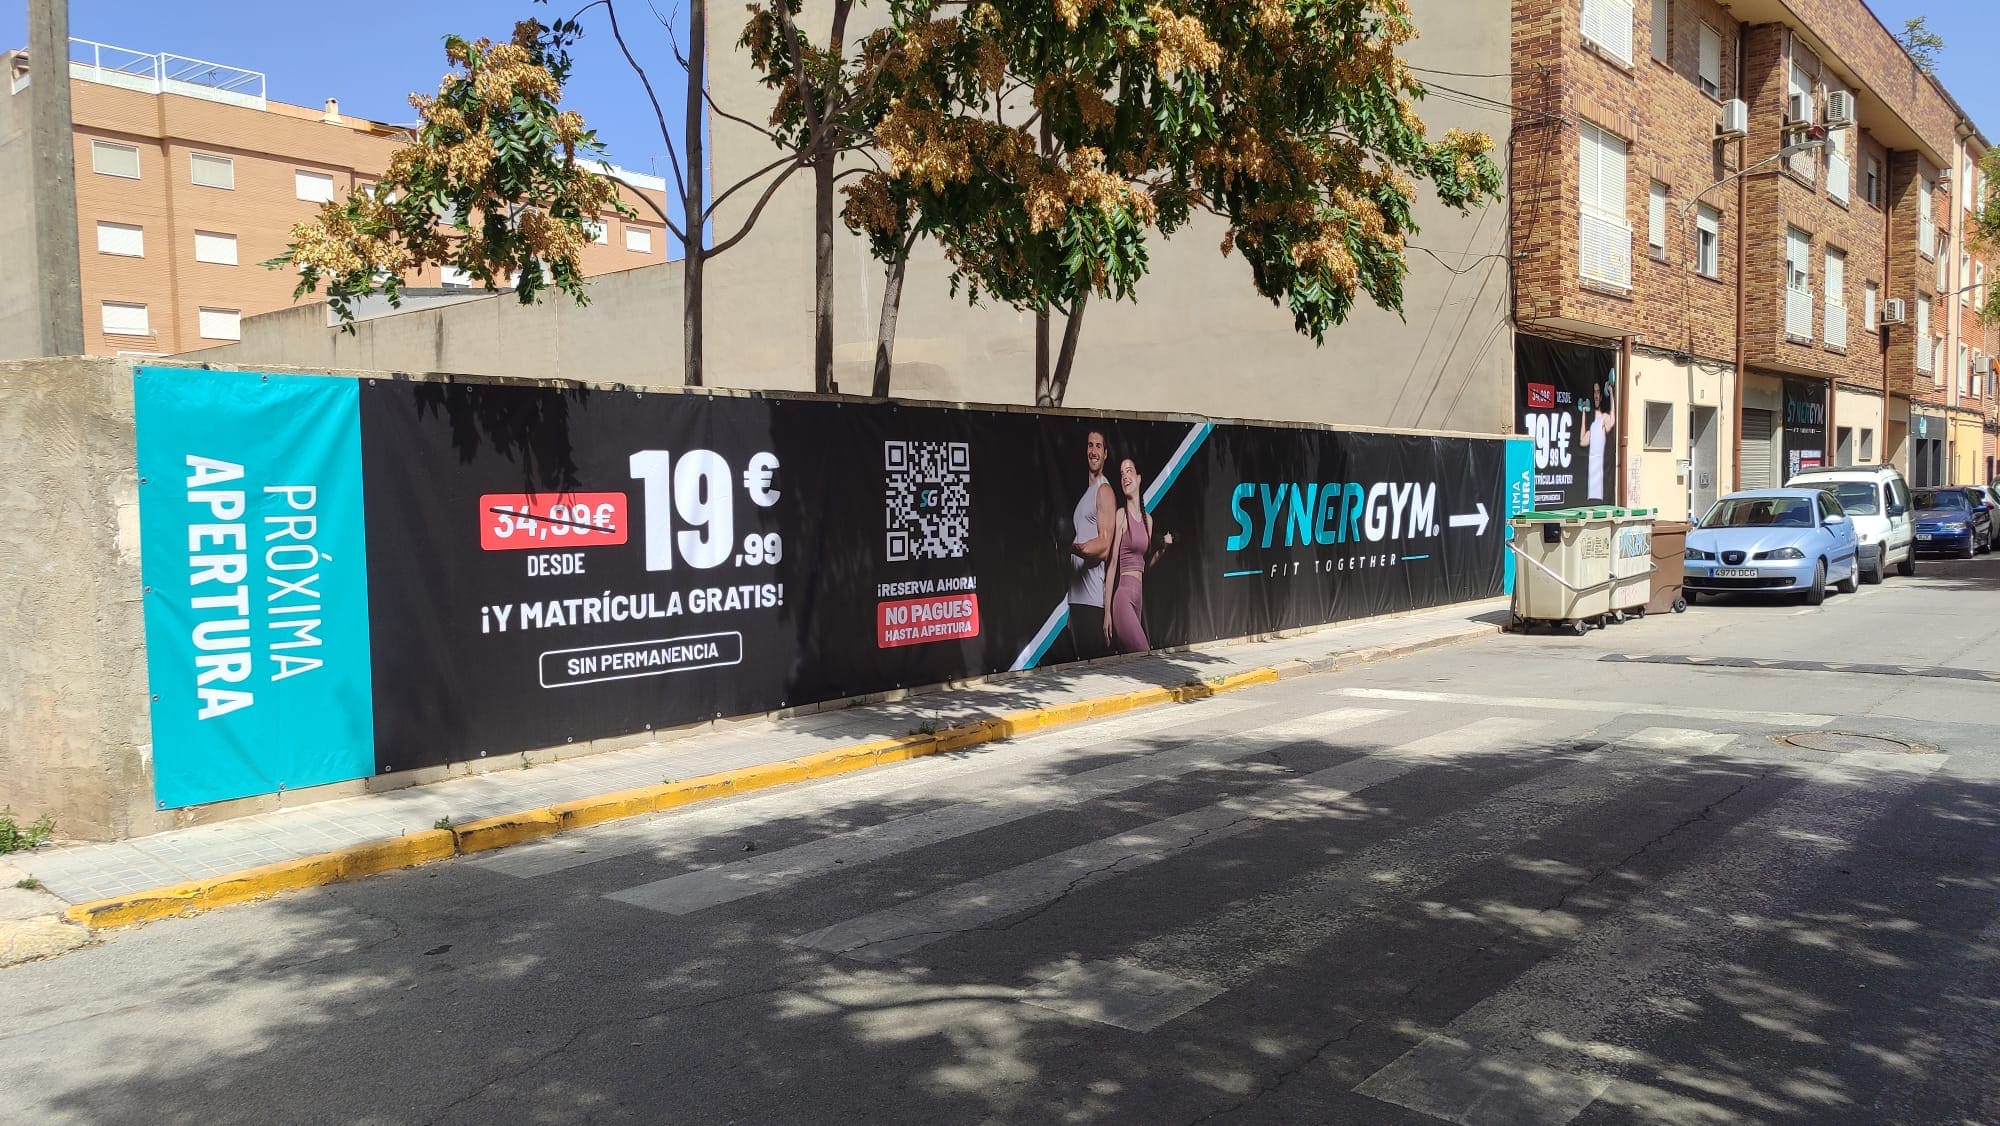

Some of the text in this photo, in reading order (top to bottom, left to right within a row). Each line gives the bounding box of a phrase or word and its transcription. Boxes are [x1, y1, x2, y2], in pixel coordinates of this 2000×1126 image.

[490, 503, 616, 541] 34,99€
[527, 553, 586, 577] DESDE
[1270, 553, 1397, 578] FIT TOGETHER
[186, 454, 254, 721] APERTURA
[263, 485, 333, 682] PRÓXIMA
[877, 575, 977, 598] ¡RESERVA AHORA!
[481, 583, 784, 634] ¡Y MATRÍCULA GRATIS!
[885, 599, 973, 626] NO PAGUES
[885, 620, 972, 642] HASTA APERTURA
[567, 642, 719, 676] SIN PERMANENCIA
